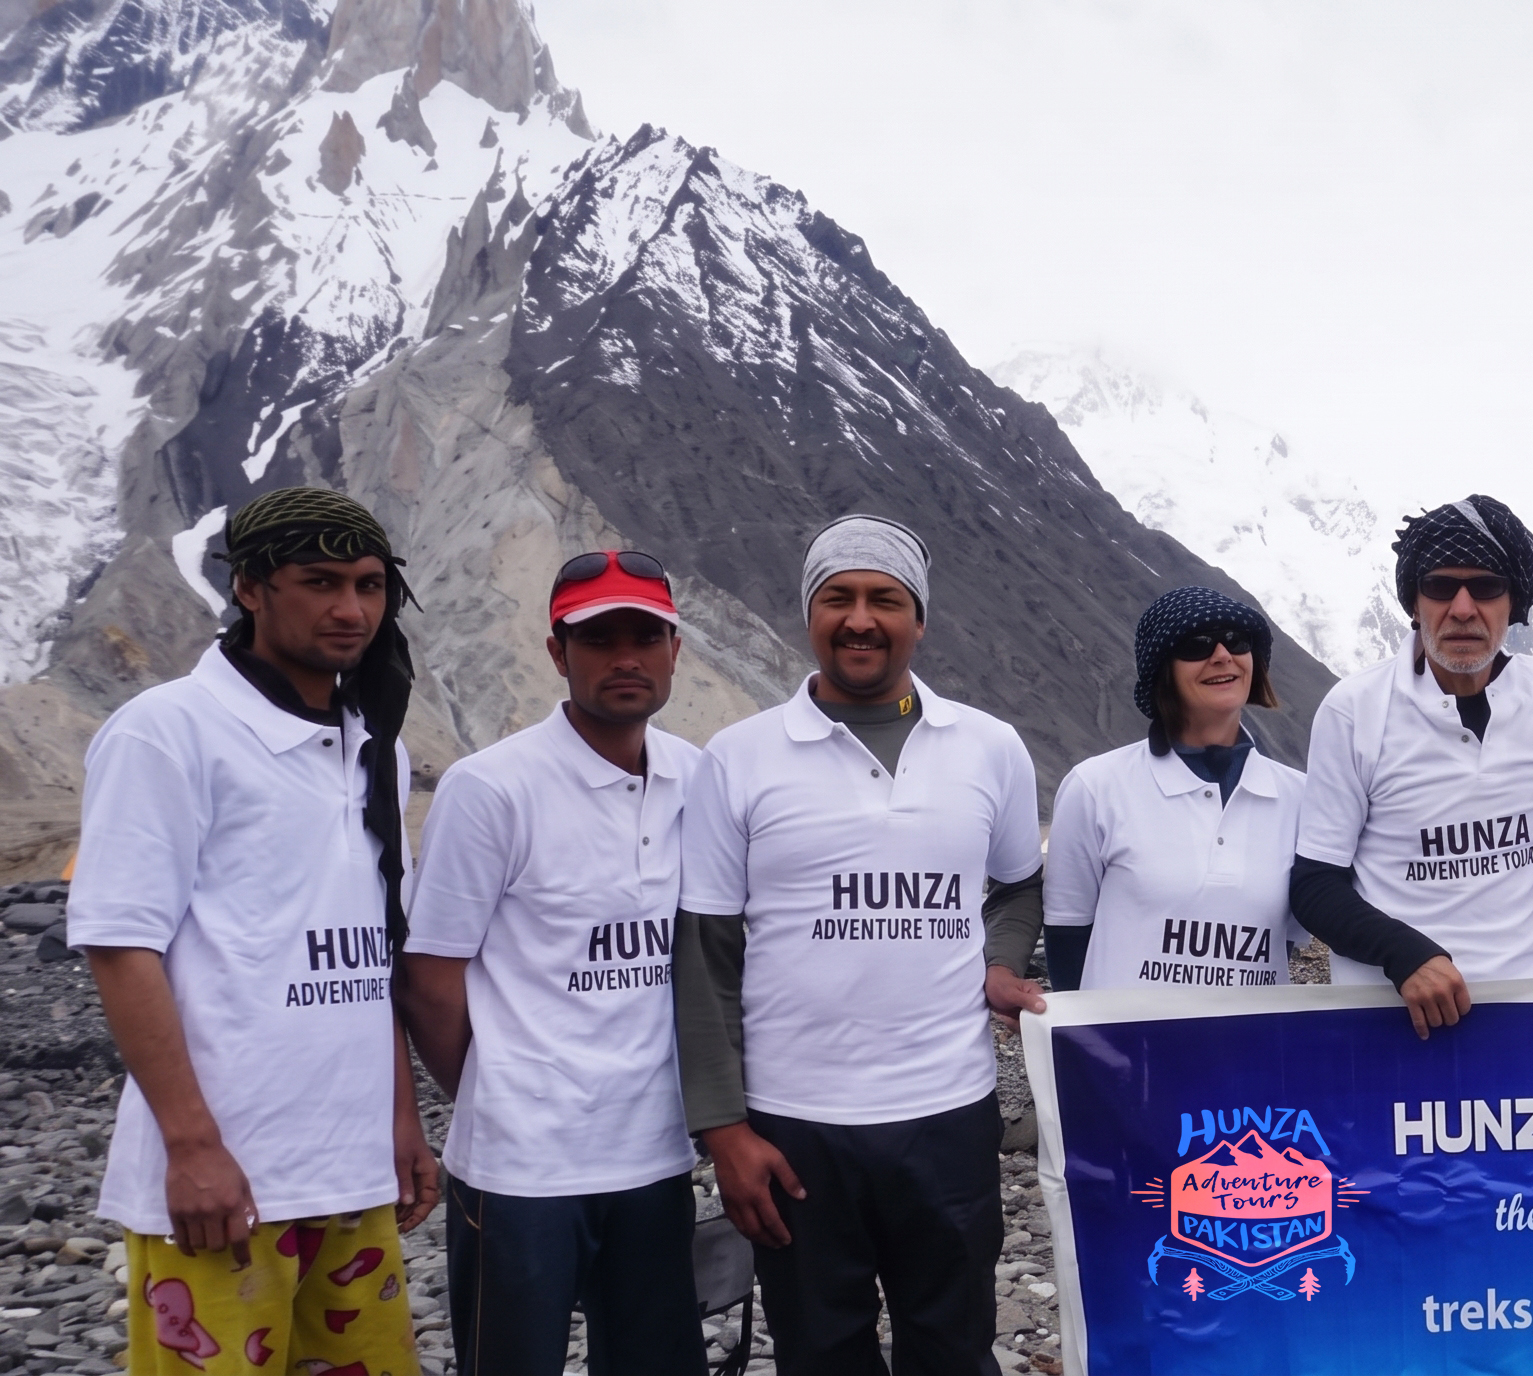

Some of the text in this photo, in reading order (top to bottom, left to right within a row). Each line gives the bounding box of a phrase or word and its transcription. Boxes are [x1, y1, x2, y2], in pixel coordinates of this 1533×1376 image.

[1420, 813, 1530, 857] HUNZA
[1405, 855, 1499, 881] ADVENTURE
[832, 872, 961, 910] HUNZA
[588, 918, 671, 961] HUN
[811, 917, 970, 940] ADVENTURE TOURS
[1162, 918, 1271, 963] HUNZA
[1138, 960, 1277, 986] ADVENTURE TOURS
[286, 978, 384, 1007] ADVENTURE
[1177, 1105, 1331, 1157] HUNZA
[1182, 1170, 1323, 1193] Adventure
[1212, 1191, 1299, 1210] Tours
[1183, 1215, 1322, 1251] PAKISTAN
